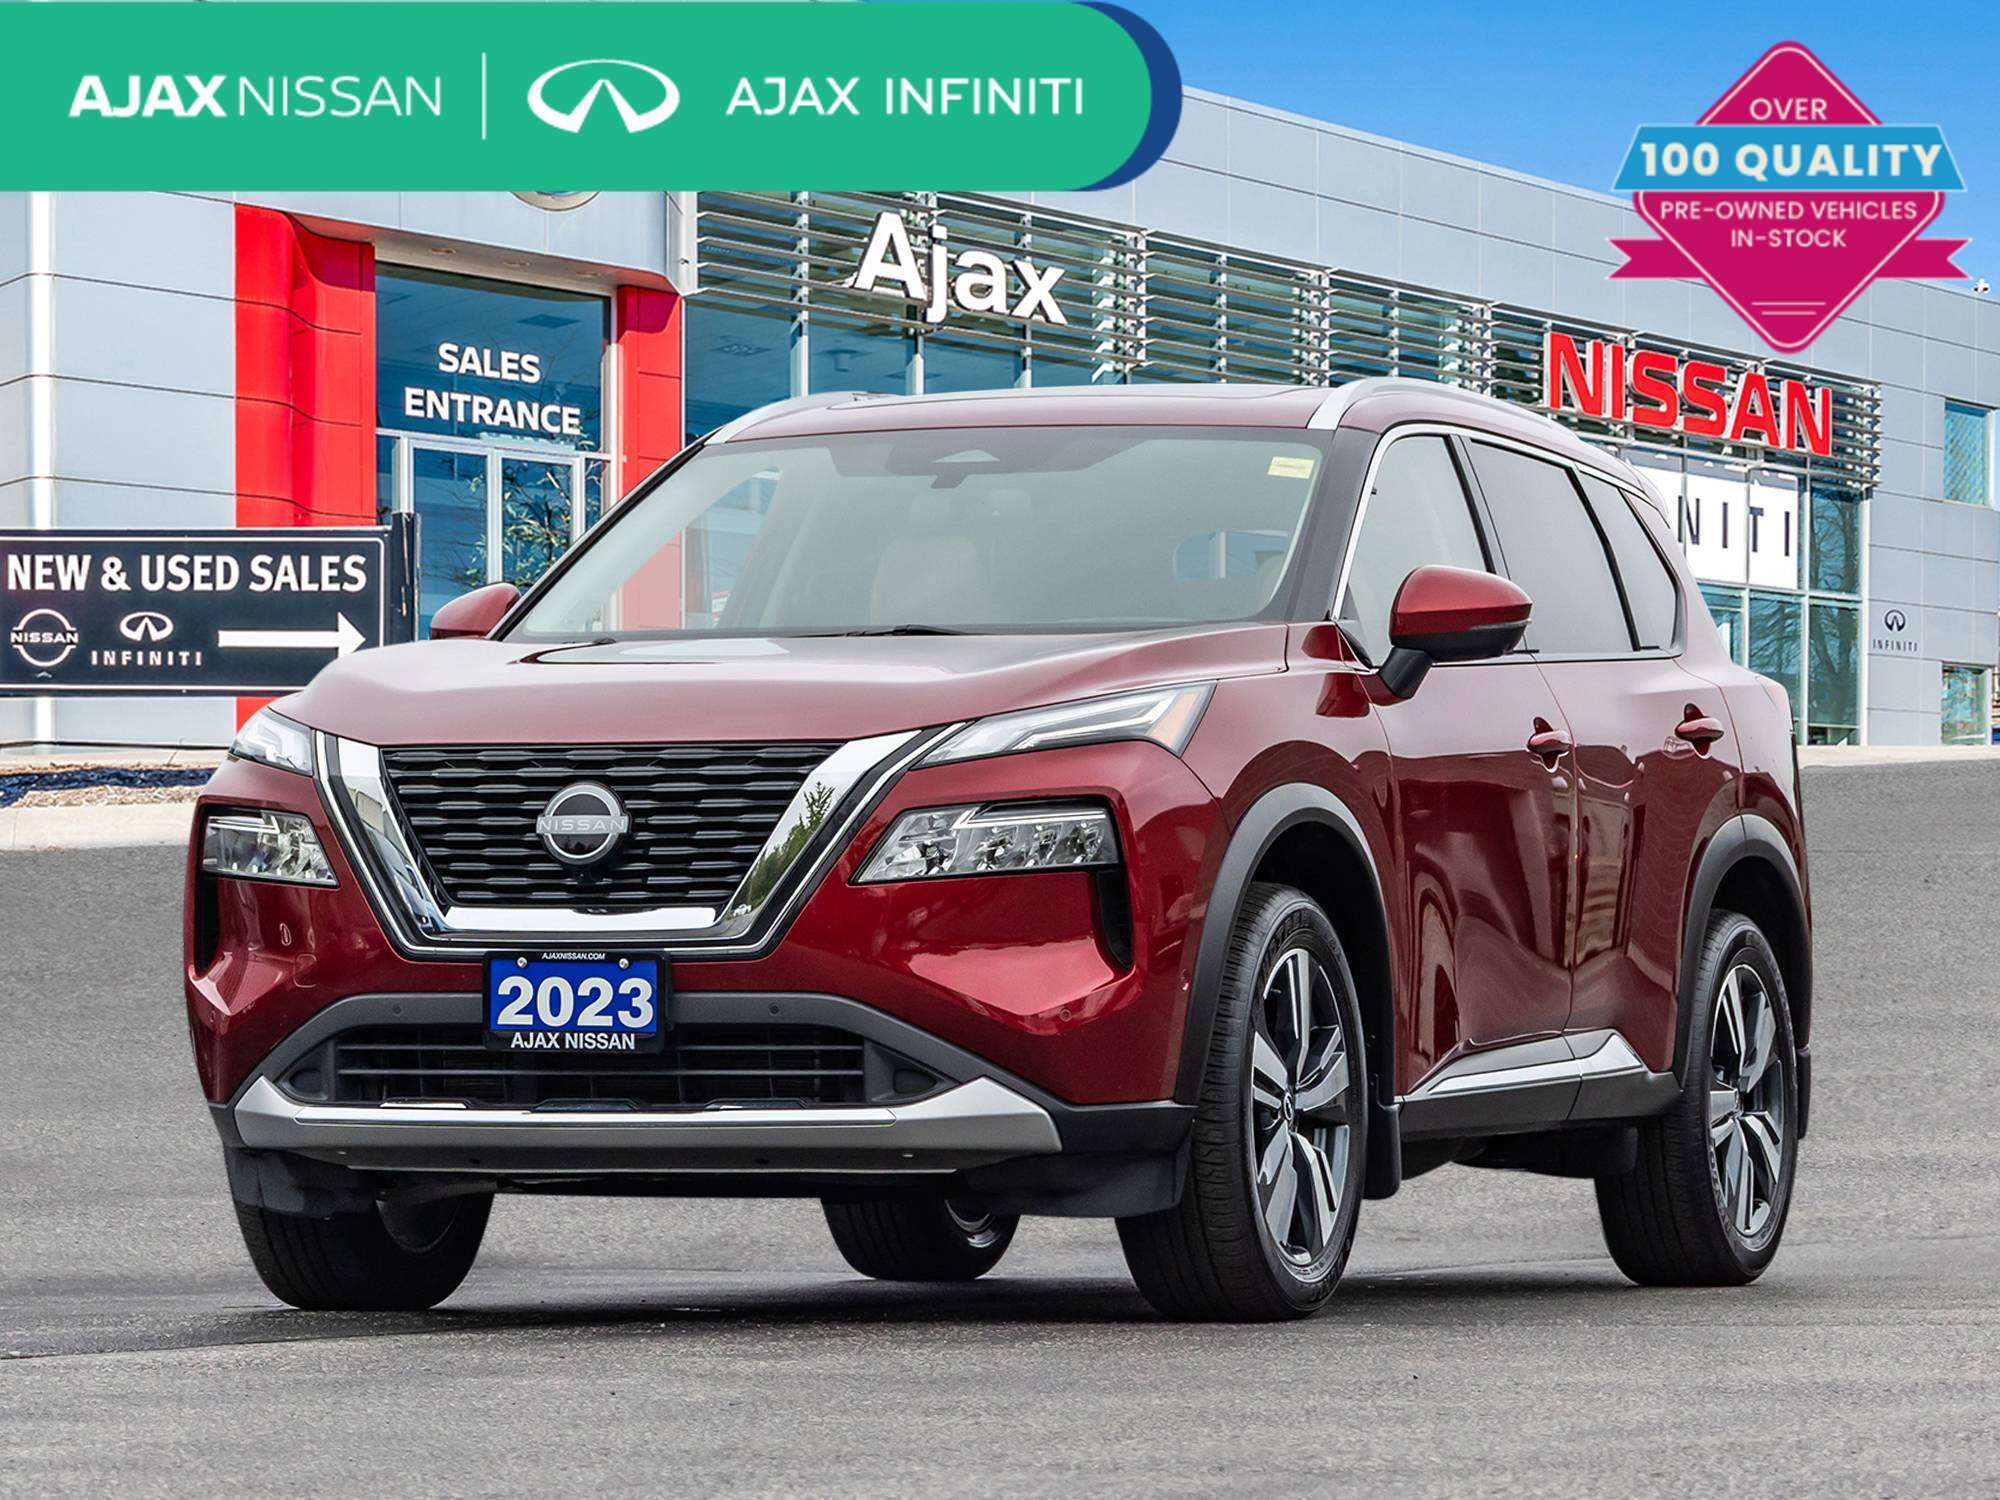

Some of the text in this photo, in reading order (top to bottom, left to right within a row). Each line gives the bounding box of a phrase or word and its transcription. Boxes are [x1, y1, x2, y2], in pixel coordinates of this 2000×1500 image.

[853, 210, 1069, 326] Ajax
[437, 342, 542, 384] SALES
[1545, 331, 1833, 457] NISSAN
[403, 386, 581, 436] ENTRANCE
[7, 553, 367, 593] NEW & USED SALES
[10, 631, 80, 644] NISSAN
[1872, 639, 1918, 652] INFINITI
[91, 650, 203, 666] INFINITI
[538, 818, 625, 832] NISSAN
[541, 952, 606, 961] AJAXNISSAN.COM
[497, 975, 654, 1029] 2023
[510, 1032, 636, 1050] AJAX NISSAN
